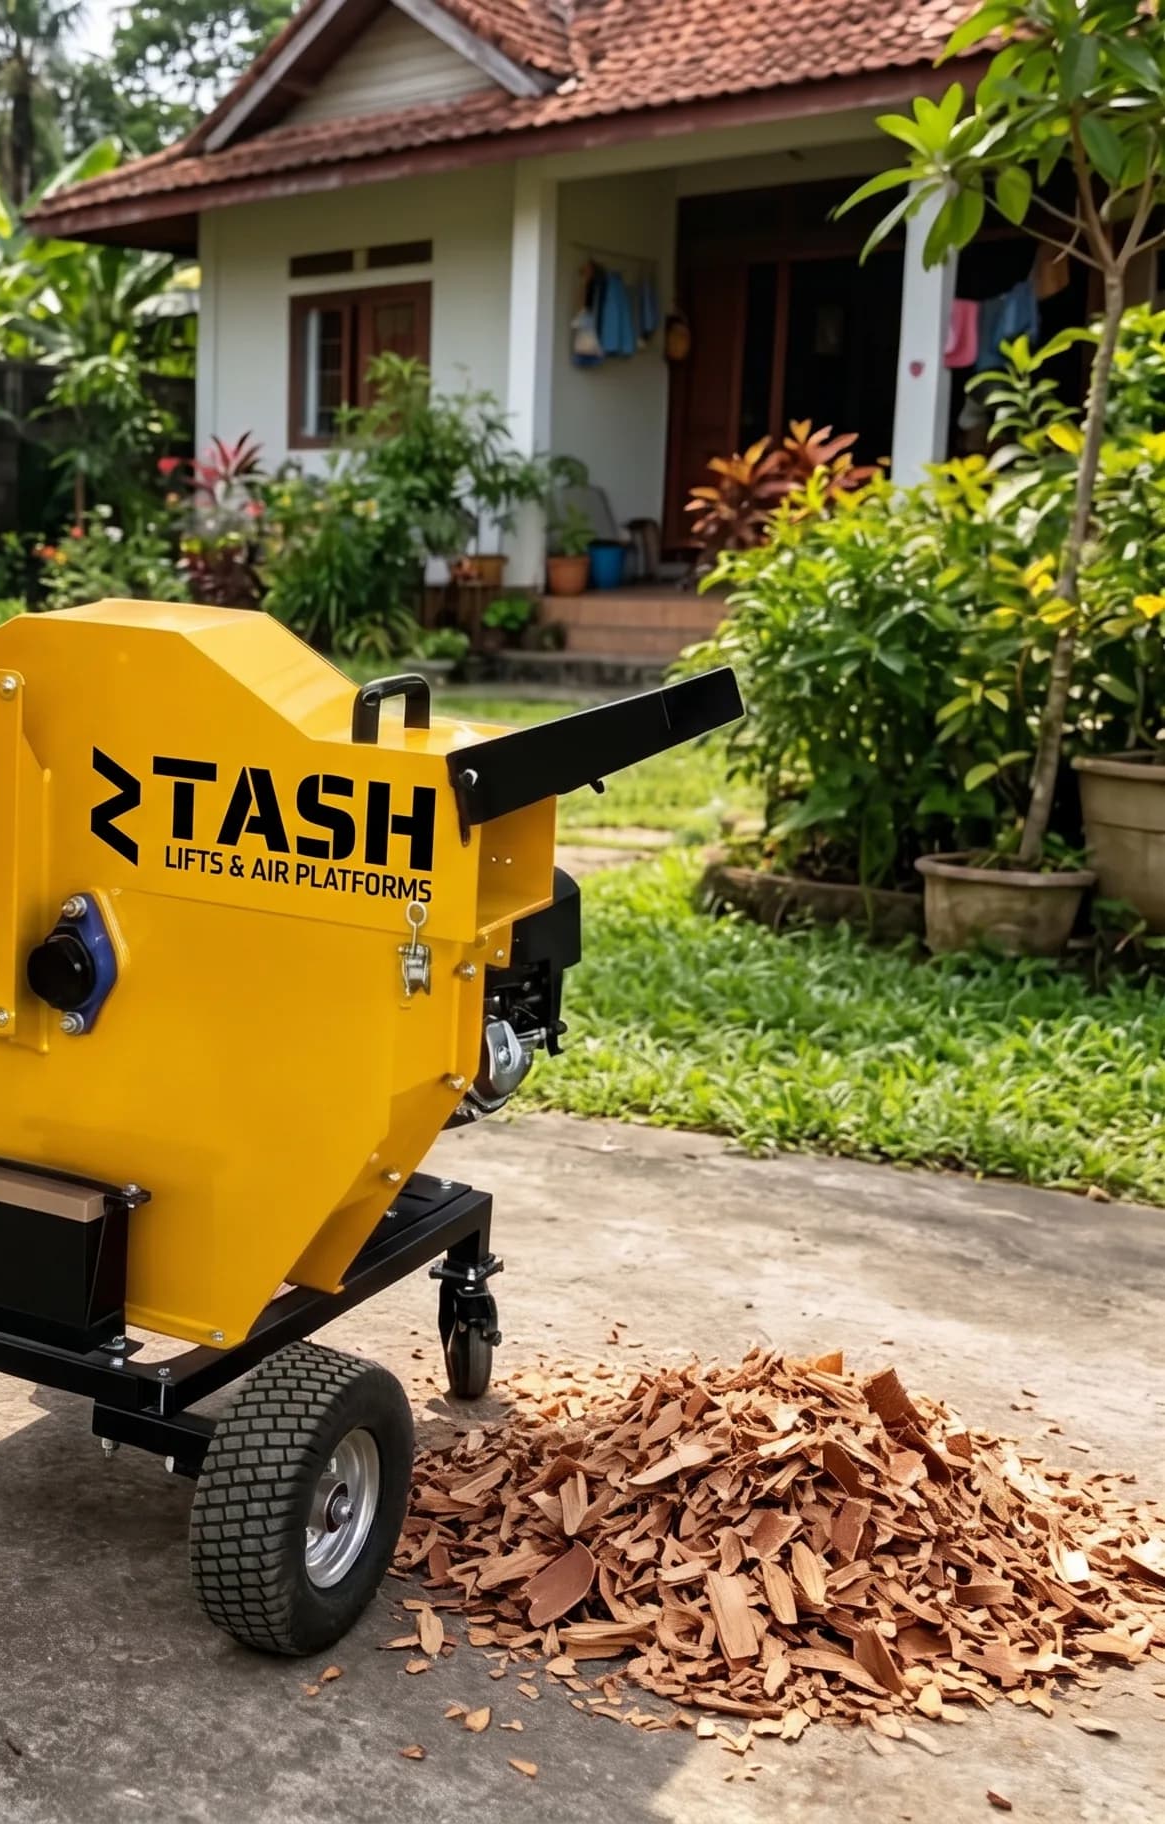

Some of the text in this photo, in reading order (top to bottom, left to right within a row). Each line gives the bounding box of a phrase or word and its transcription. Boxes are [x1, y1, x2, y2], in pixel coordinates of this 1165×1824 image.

[152, 755, 437, 872] TASH
[165, 845, 432, 903] LIFTS & AIR PLATFORMS
